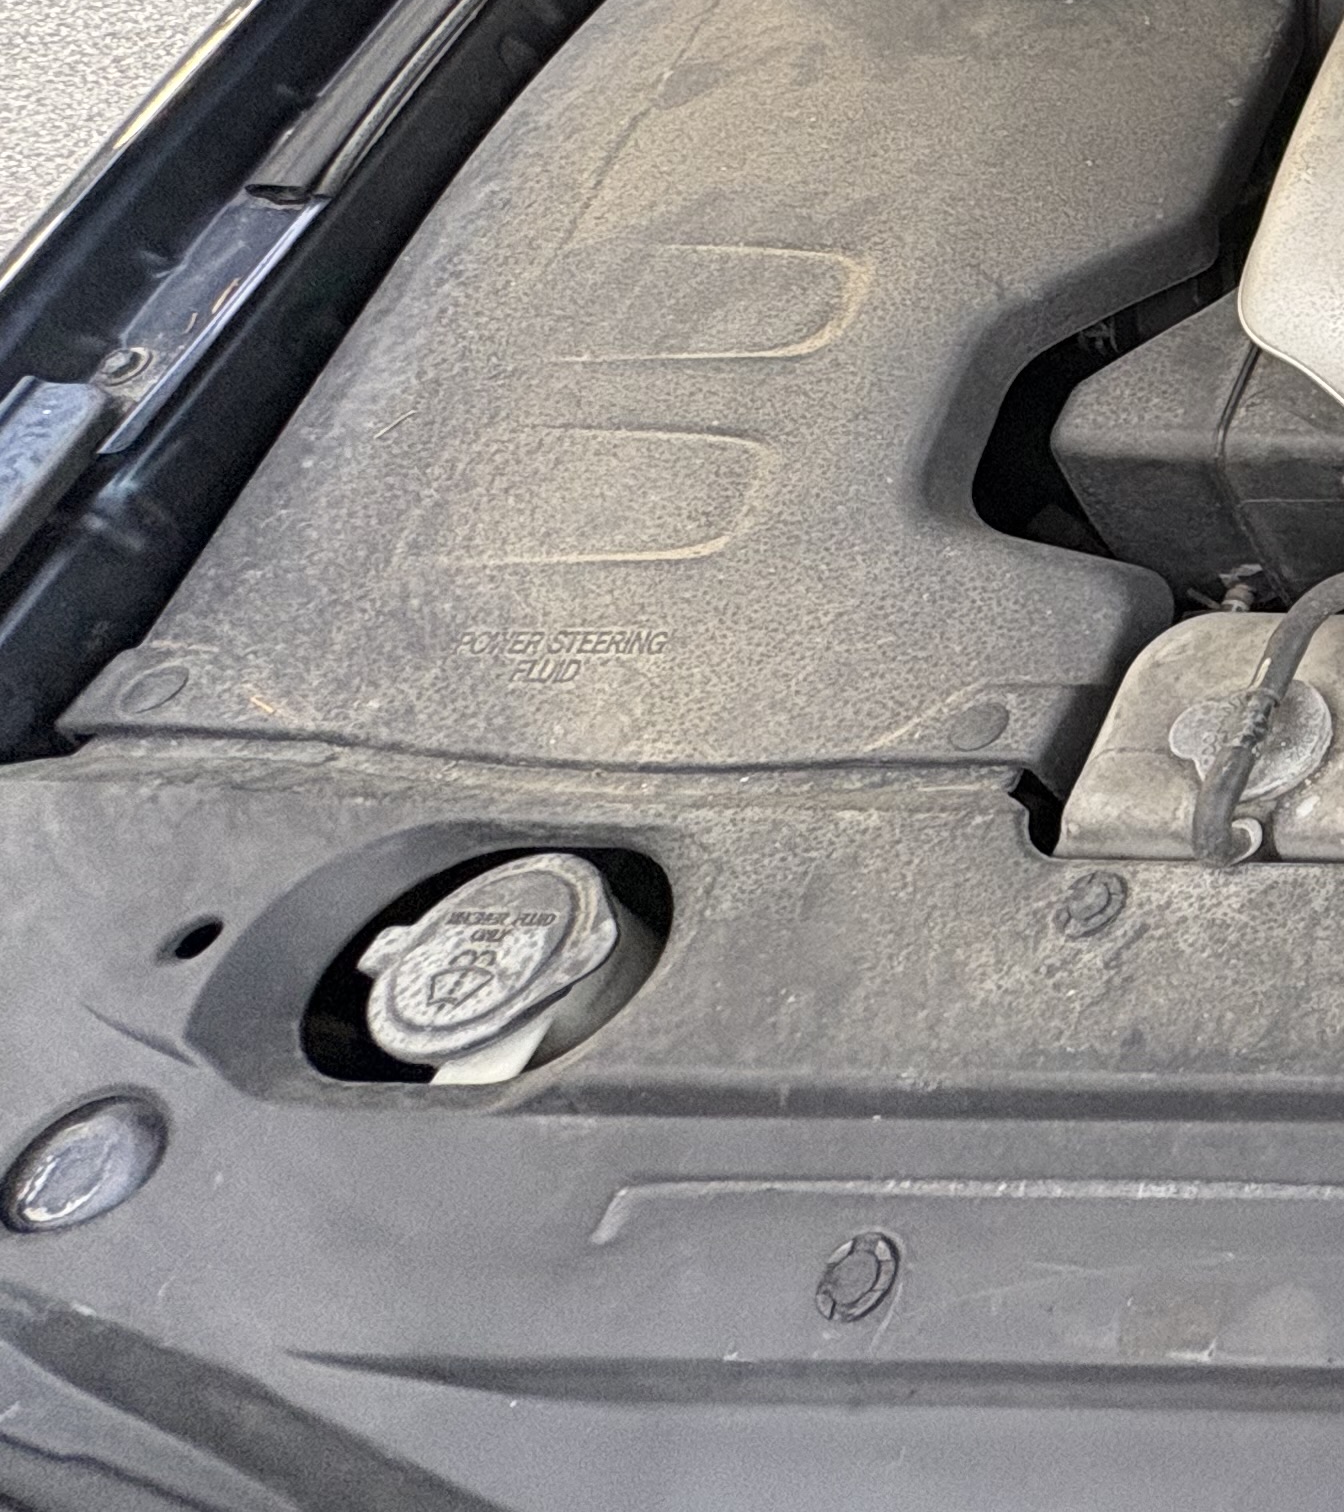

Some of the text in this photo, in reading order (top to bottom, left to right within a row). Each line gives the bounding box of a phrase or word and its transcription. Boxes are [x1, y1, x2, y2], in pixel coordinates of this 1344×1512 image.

[453, 630, 668, 655] POWER STEERING
[509, 659, 582, 684] FLUID
